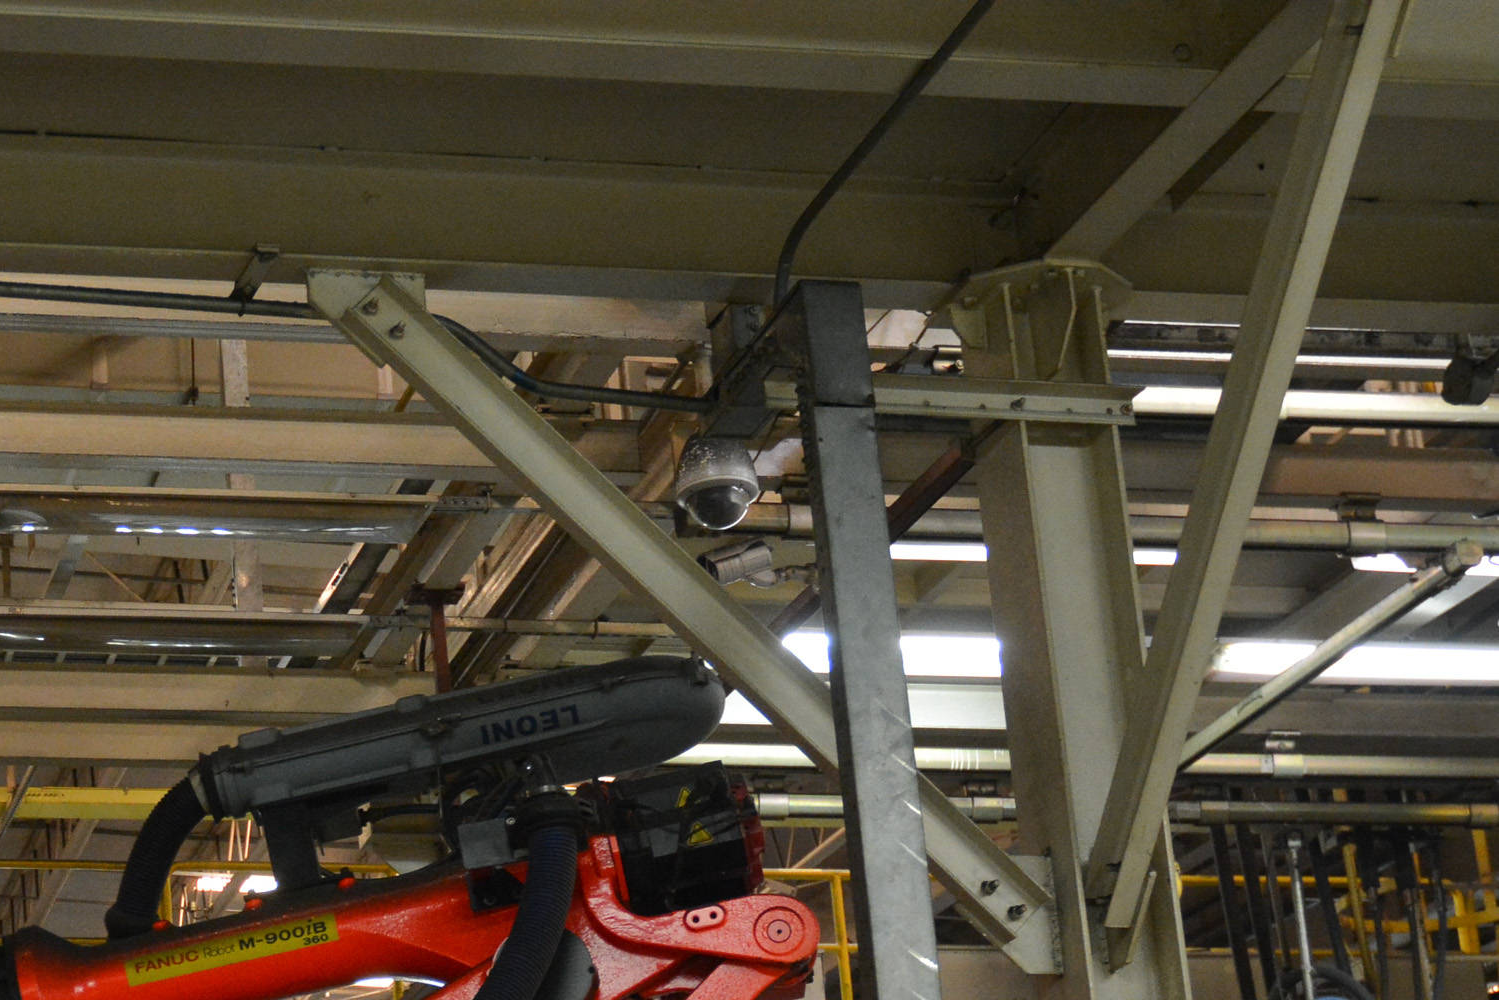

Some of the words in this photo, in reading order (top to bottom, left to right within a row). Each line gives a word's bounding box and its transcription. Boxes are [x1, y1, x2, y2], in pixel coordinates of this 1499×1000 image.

[480, 703, 580, 745] LEONI
[134, 951, 200, 974] FANUC
[203, 944, 236, 958] Robot
[239, 919, 327, 951] M-900iB
[303, 933, 329, 946] 360
